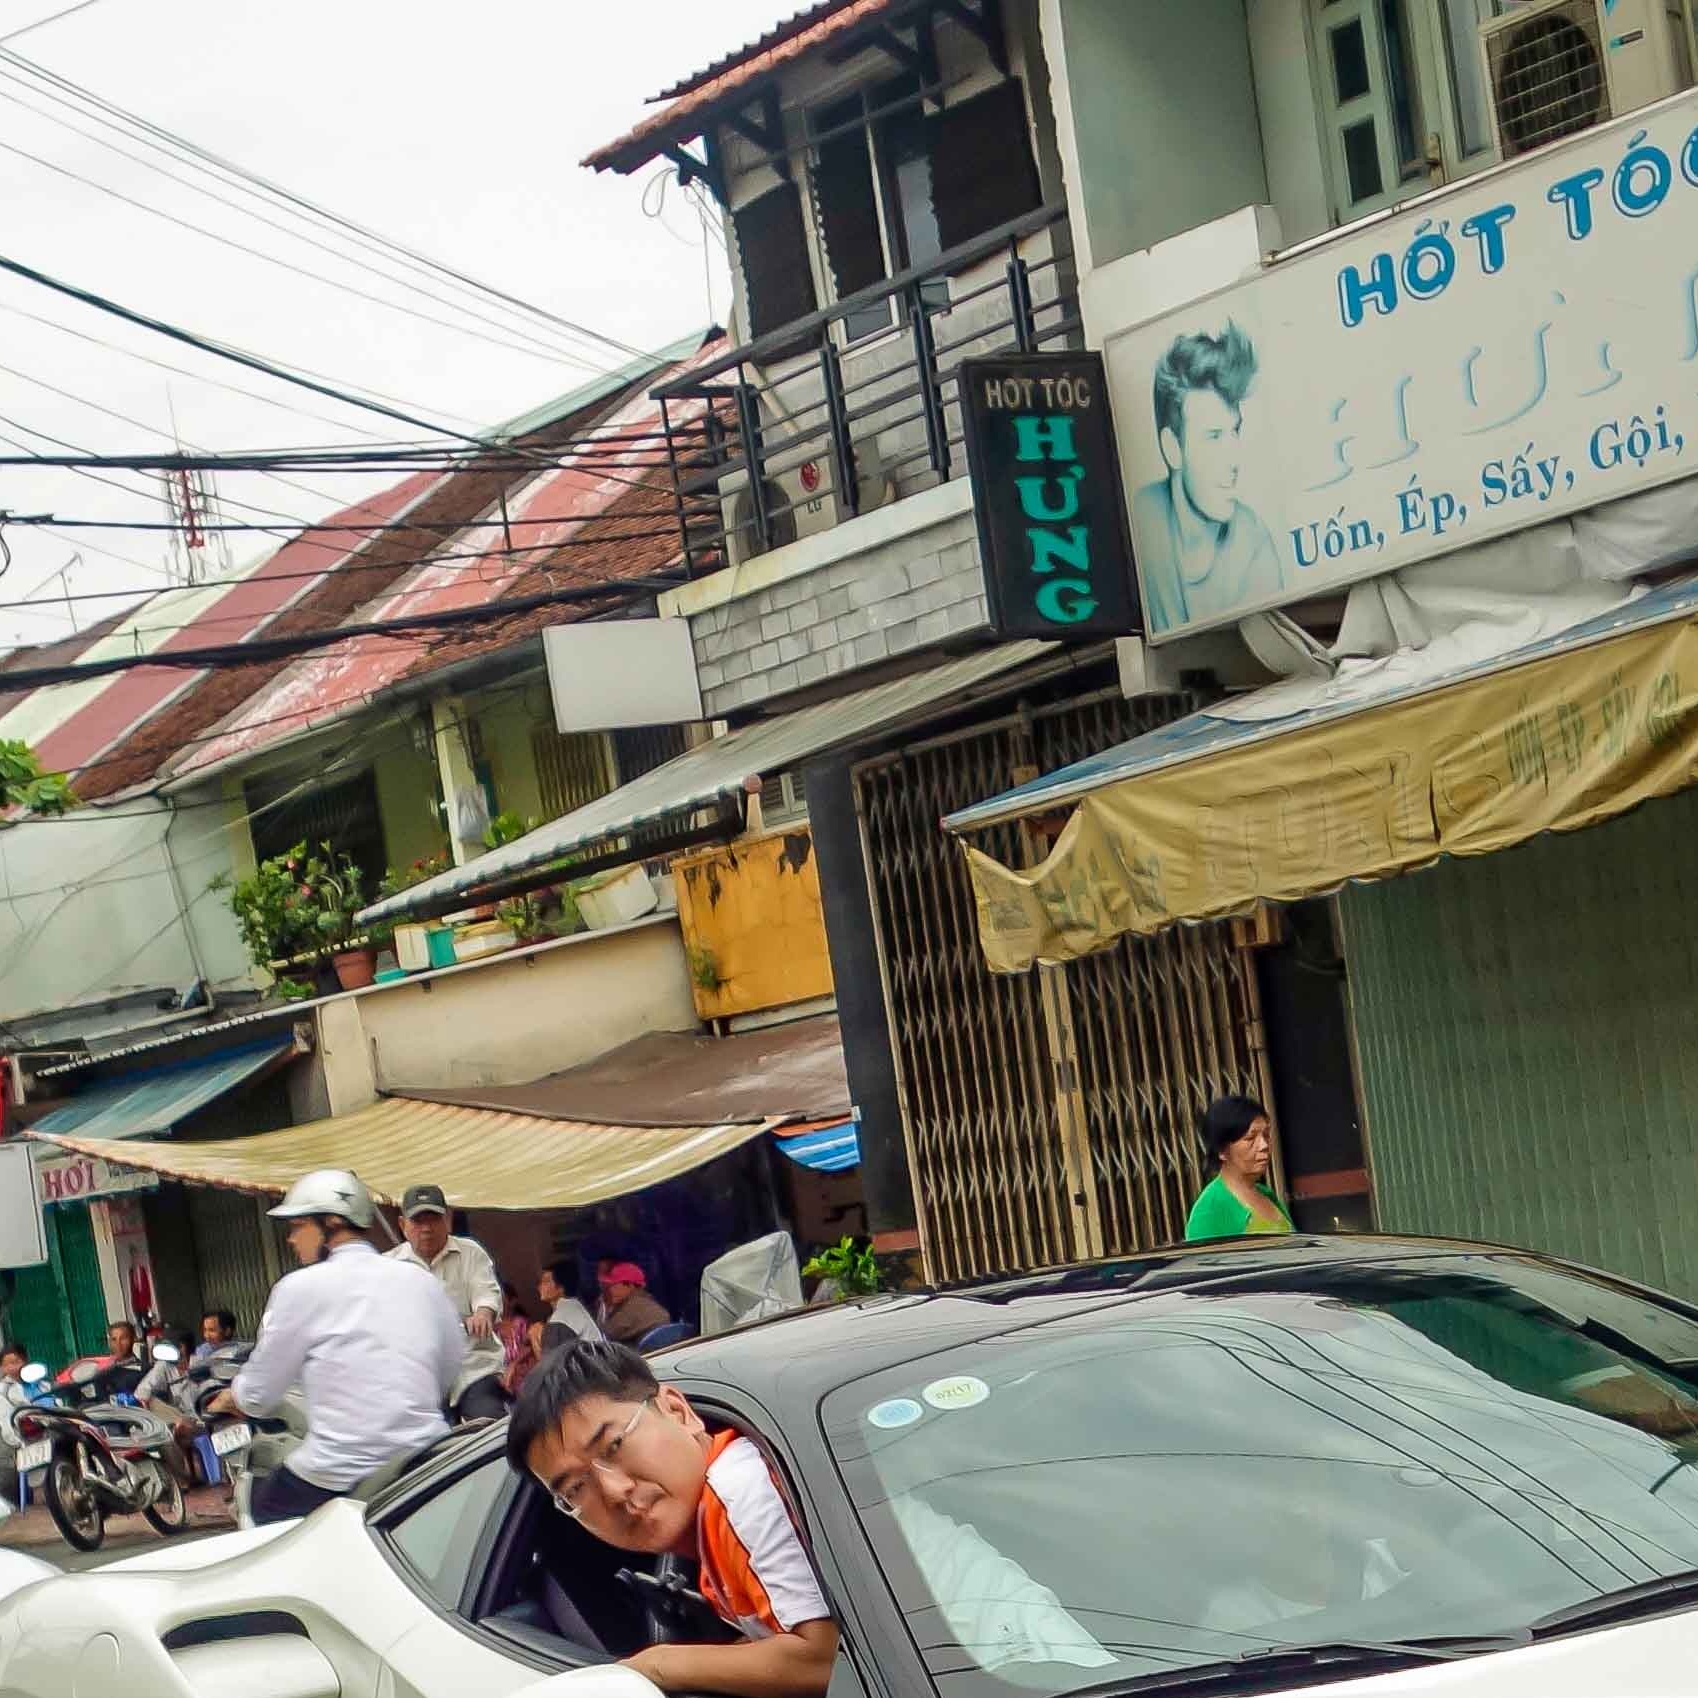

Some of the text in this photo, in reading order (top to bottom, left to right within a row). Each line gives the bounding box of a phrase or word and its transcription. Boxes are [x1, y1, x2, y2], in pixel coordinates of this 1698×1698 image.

[1337, 203, 1516, 328] HỚT
[1011, 415, 1100, 624] HƯNG
[1288, 506, 1386, 569] Uốn,
[1395, 473, 1468, 537] Ép,
[1480, 443, 1575, 509] Sấy,
[1589, 405, 1685, 471] Gội,
